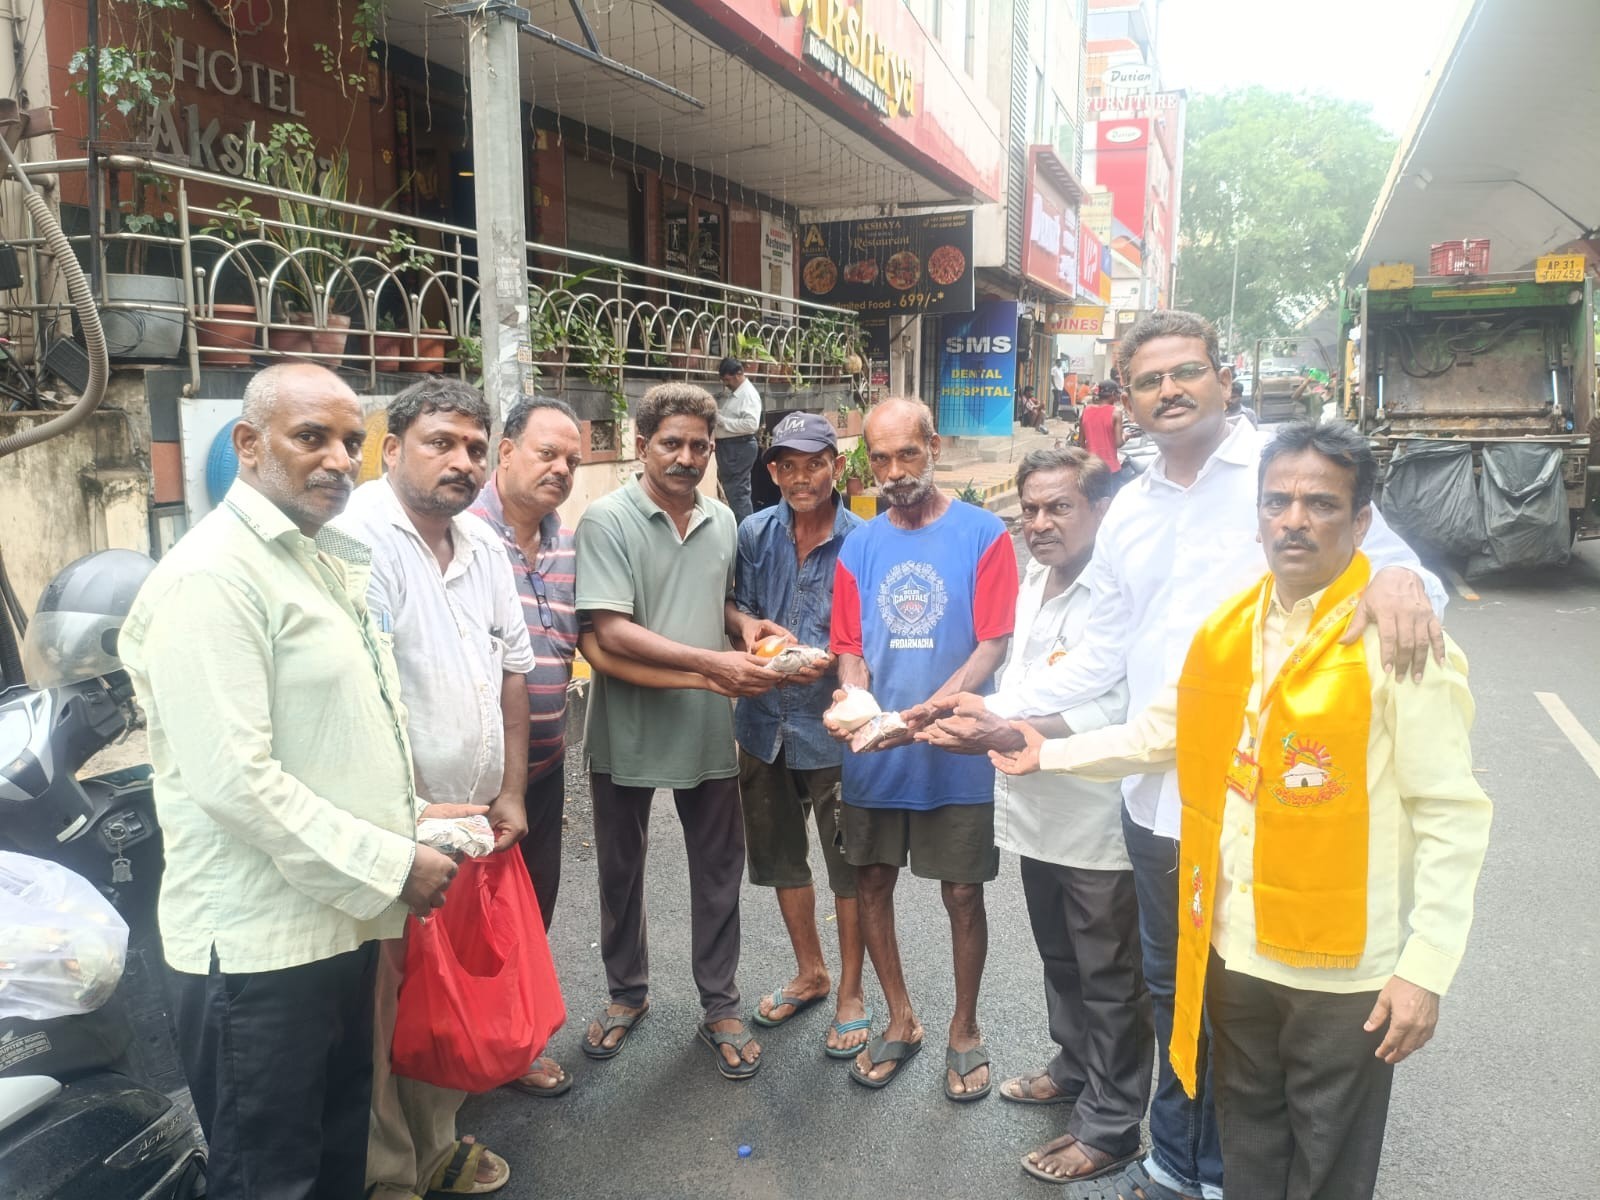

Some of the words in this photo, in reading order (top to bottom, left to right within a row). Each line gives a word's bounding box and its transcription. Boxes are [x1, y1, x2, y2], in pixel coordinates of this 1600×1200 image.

[809, 34, 835, 72] ROOMS
[837, 56, 844, 77] &
[174, 36, 306, 118] HOTEL
[1111, 69, 1151, 82] Durian
[853, 236, 910, 250] Restaurant
[1563, 260, 1575, 269] 31
[868, 299, 891, 309] Food
[946, 336, 1012, 353] SMS
[952, 369, 1002, 379] DENTAL
[942, 386, 1012, 397] HOSPITAL
[894, 594, 928, 603] CAPITALS
